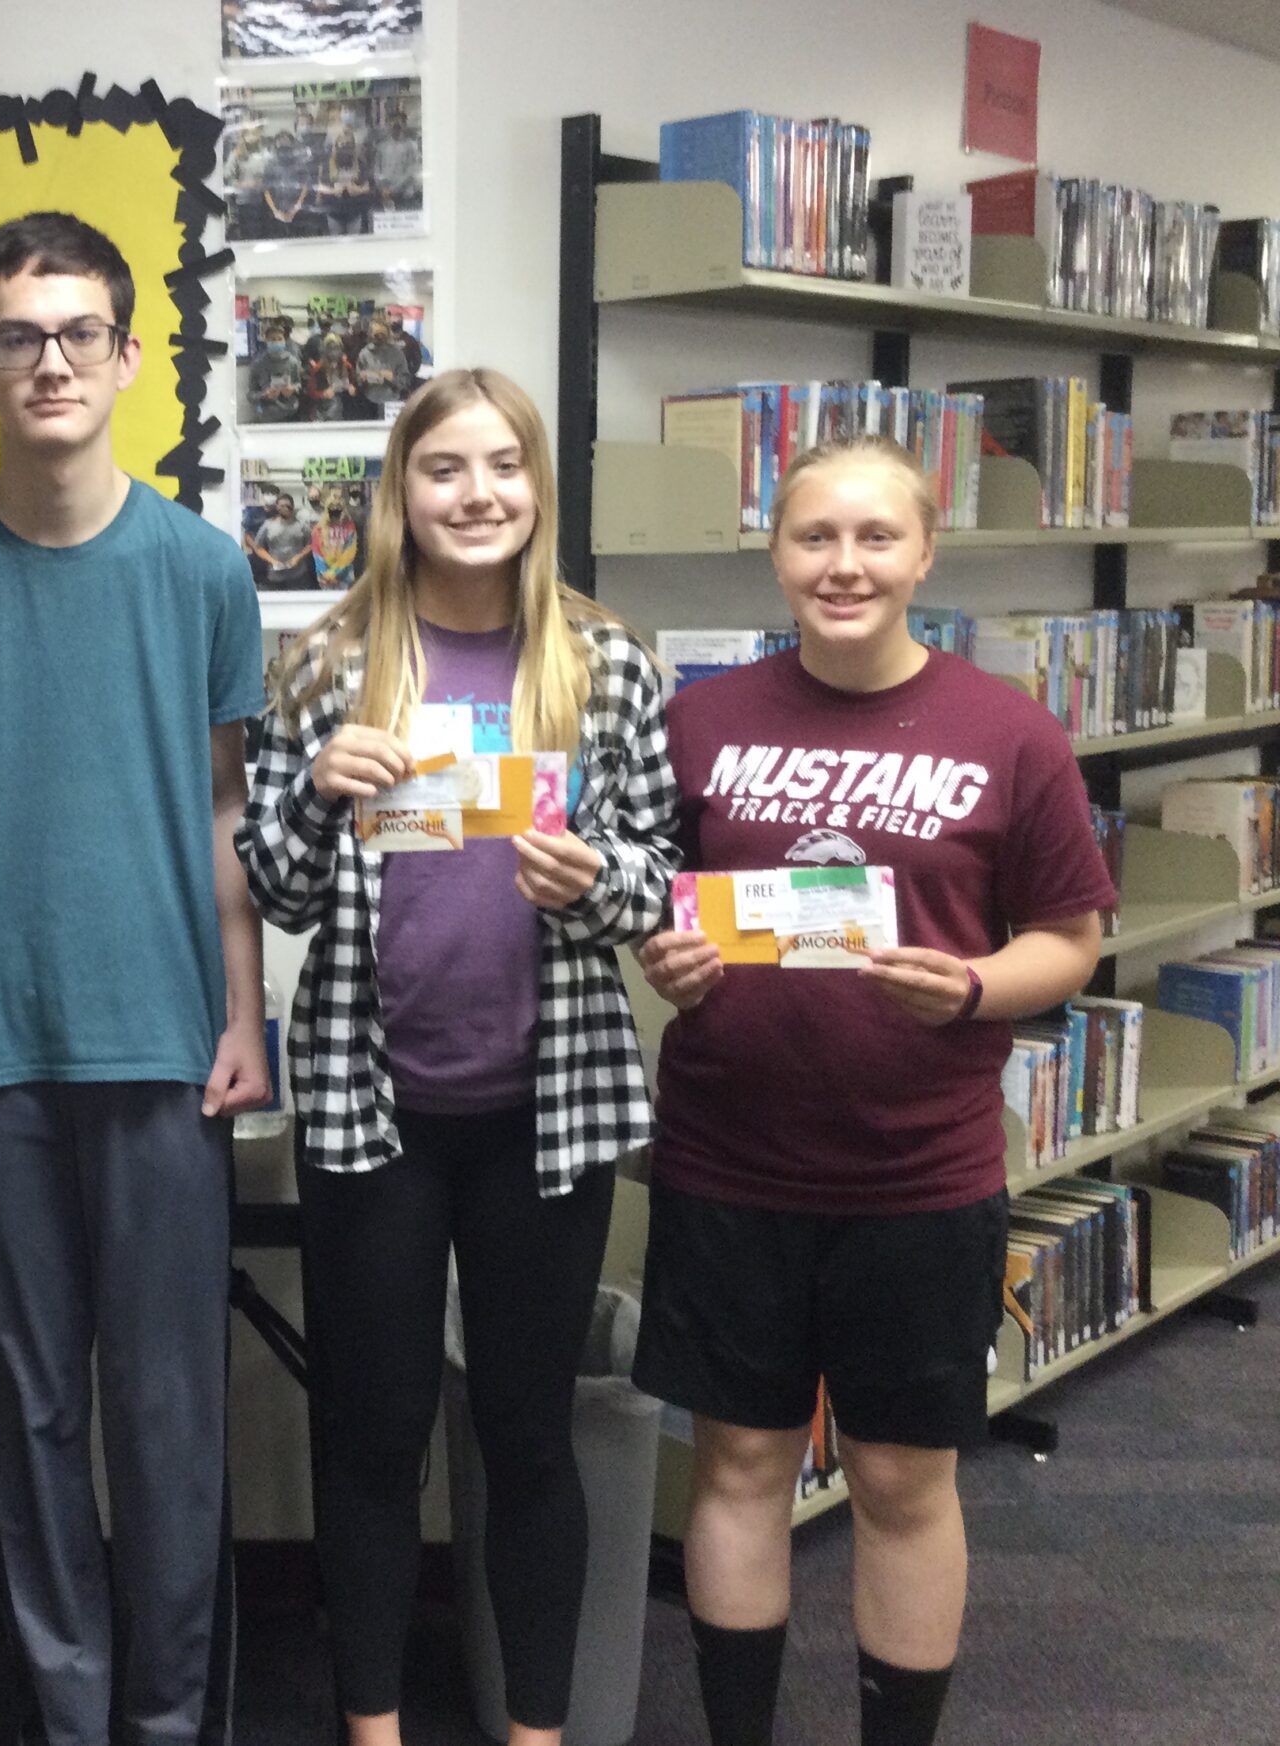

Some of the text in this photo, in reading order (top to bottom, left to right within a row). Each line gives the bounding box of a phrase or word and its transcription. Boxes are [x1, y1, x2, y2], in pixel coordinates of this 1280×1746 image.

[303, 456, 366, 481] READ
[702, 745, 989, 820] MUSTANG
[375, 819, 447, 835] SMOOTHIE
[727, 798, 943, 840] TRACK & FIELD
[745, 883, 776, 898] FREE
[793, 935, 869, 950] SMOOTHIE
